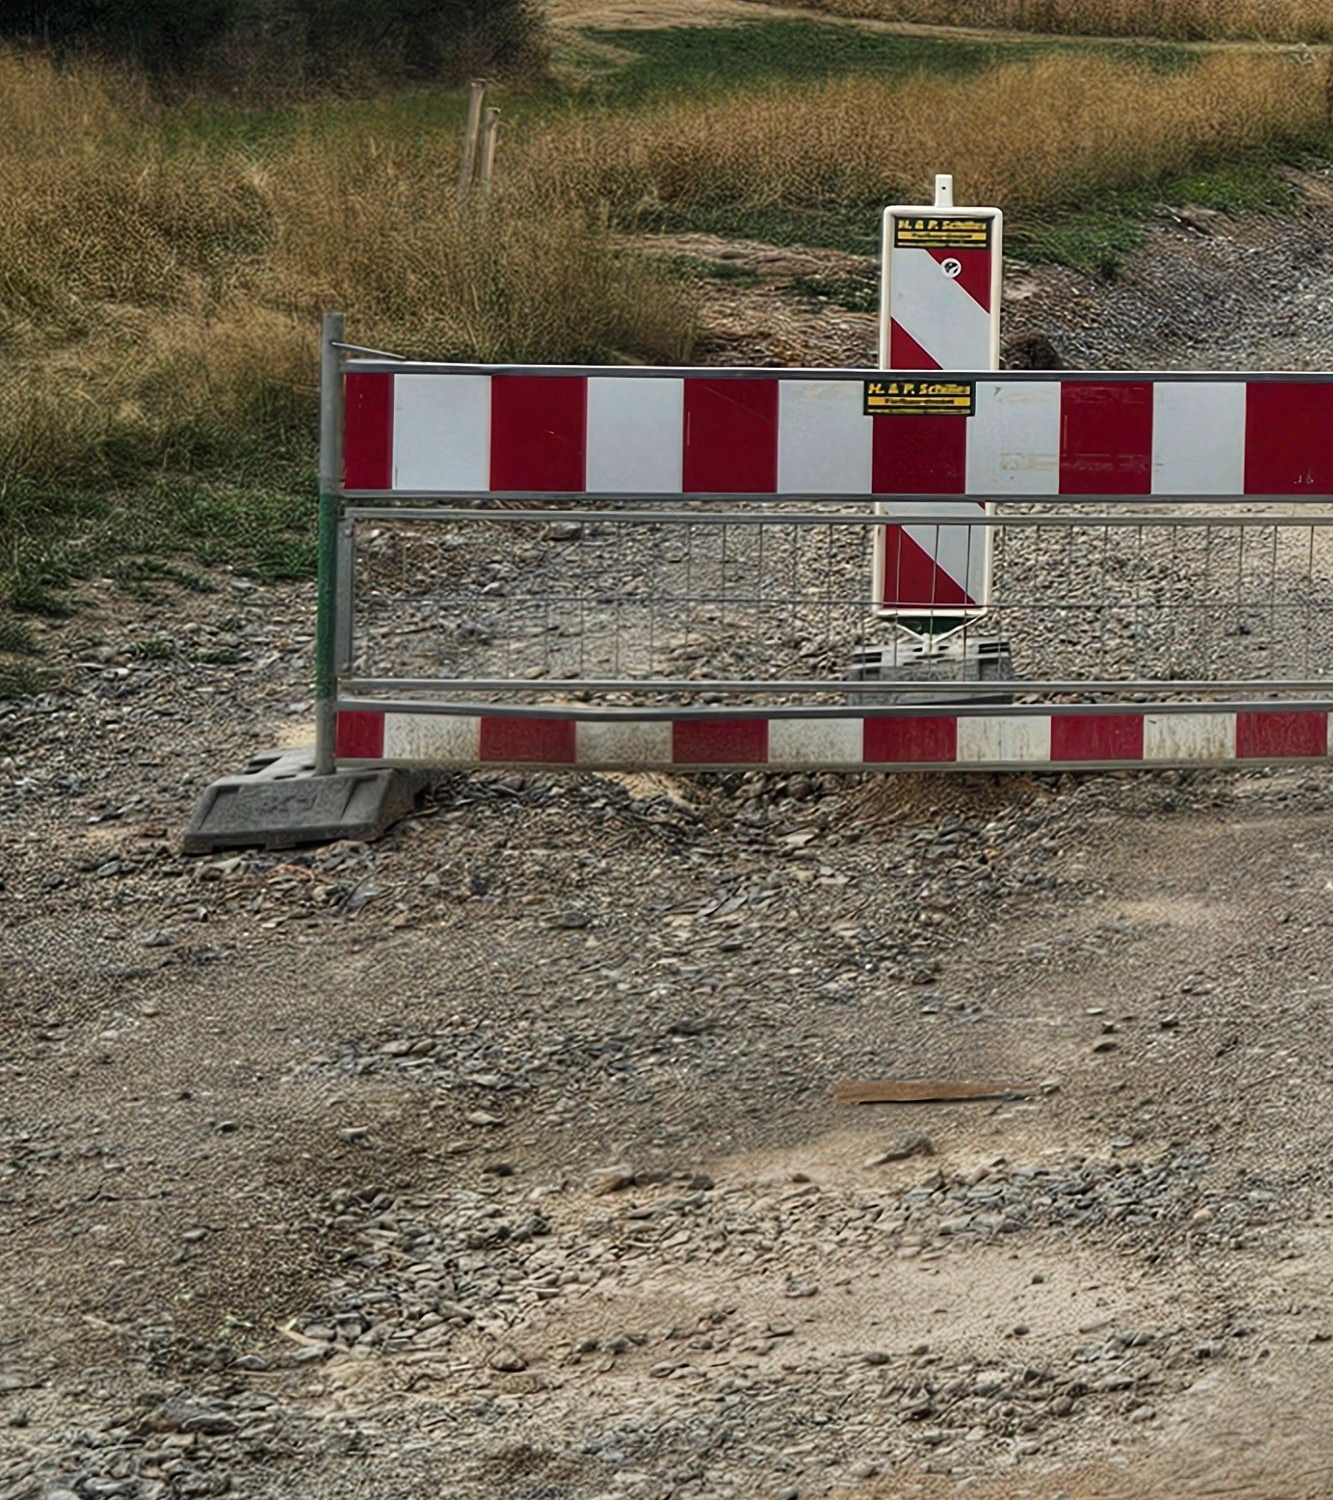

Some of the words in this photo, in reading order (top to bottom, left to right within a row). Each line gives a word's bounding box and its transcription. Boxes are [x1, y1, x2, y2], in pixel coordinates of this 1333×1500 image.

[898, 220, 912, 229] H.
[927, 220, 939, 229] P.
[868, 383, 885, 394] H.
[903, 383, 915, 394] P.
